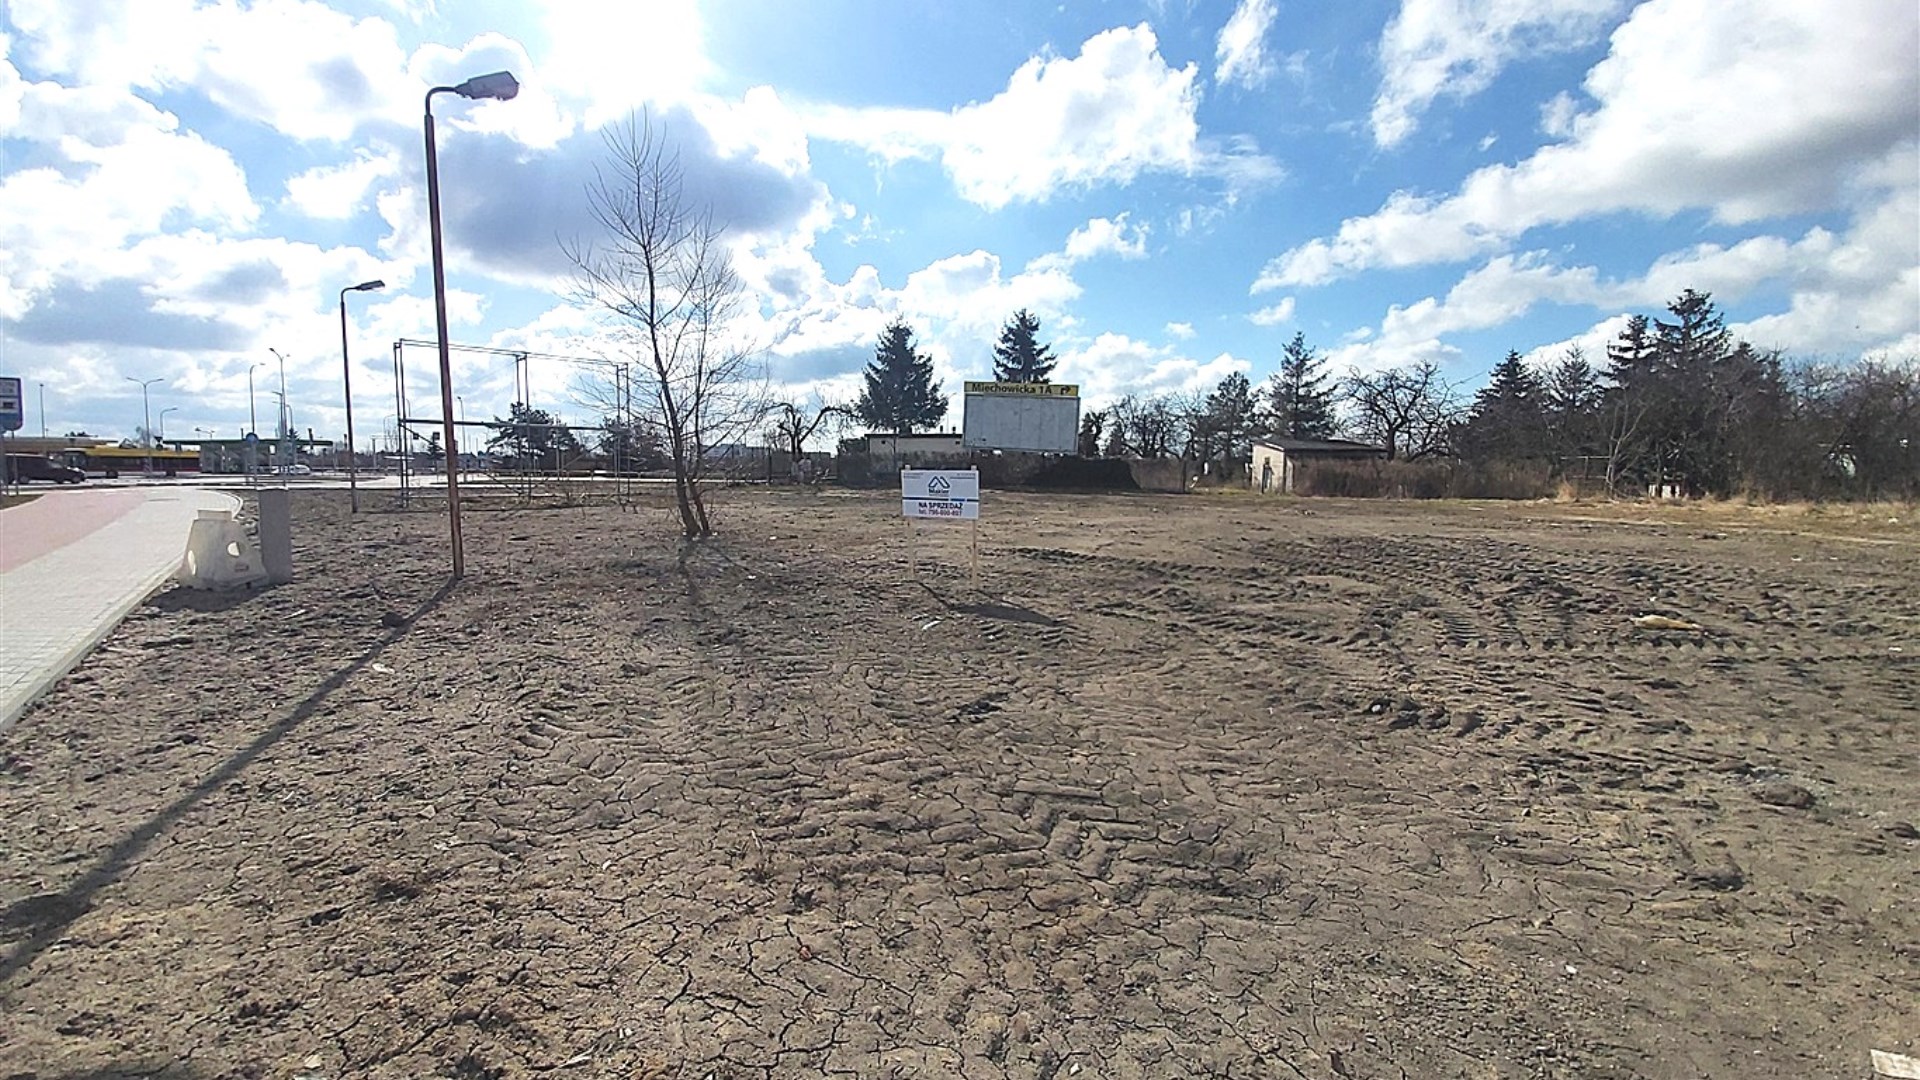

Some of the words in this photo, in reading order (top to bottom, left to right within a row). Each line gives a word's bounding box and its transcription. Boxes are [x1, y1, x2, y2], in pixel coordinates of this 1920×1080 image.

[971, 382, 1036, 394] Miechowicka
[1040, 385, 1052, 394] 1A
[928, 502, 963, 510] SPRZEDAŻ
